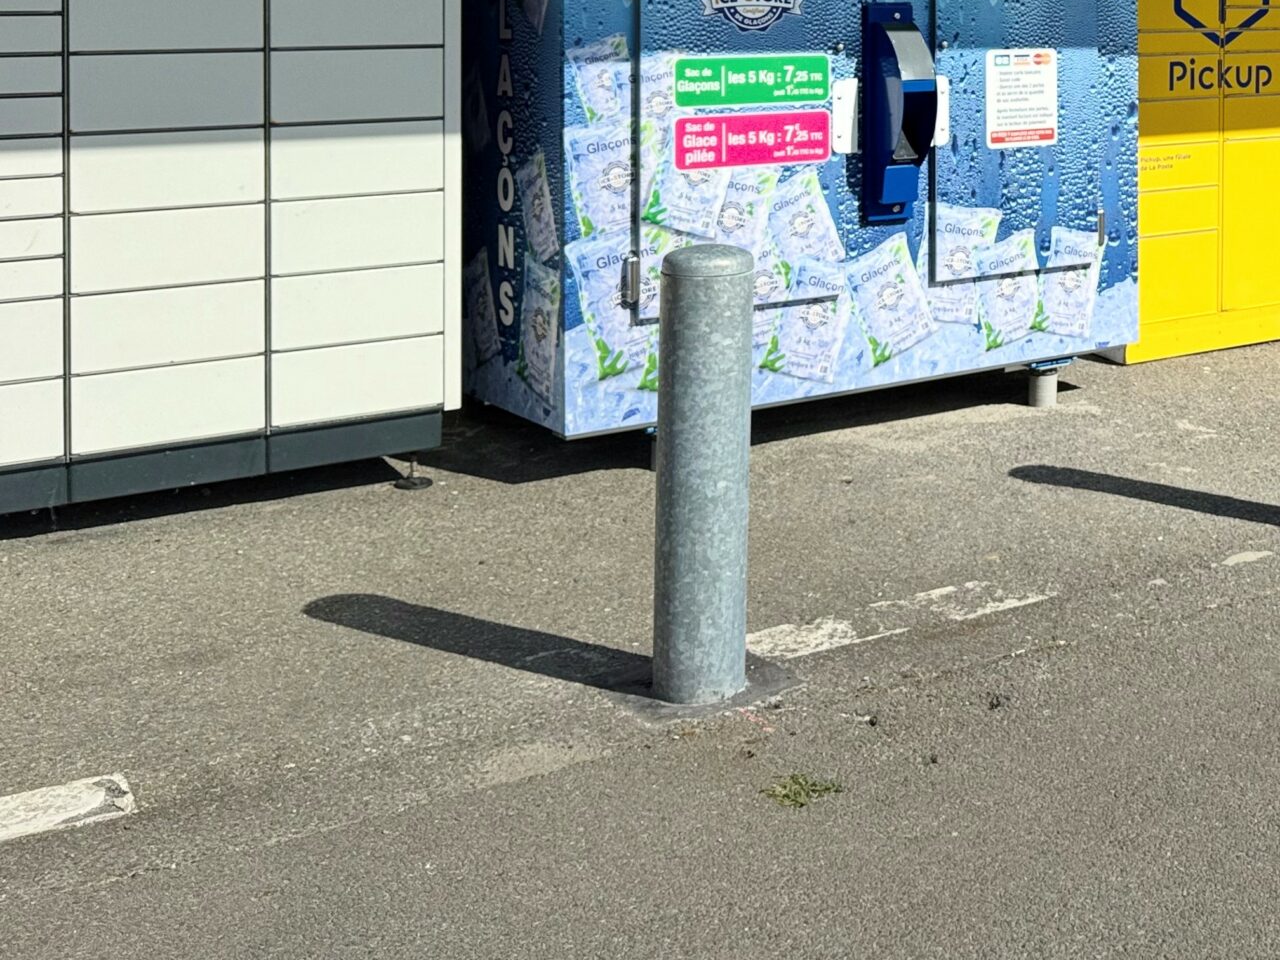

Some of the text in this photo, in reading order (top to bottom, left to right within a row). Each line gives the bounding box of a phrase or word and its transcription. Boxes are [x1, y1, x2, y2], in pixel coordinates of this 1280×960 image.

[684, 68, 713, 77] Sac de
[728, 71, 746, 84] les
[748, 70, 757, 83] 5
[758, 69, 775, 85] Kg
[1168, 57, 1273, 94] Pickup
[677, 80, 720, 94] Glaçons
[684, 121, 715, 133] Sac de
[682, 134, 718, 148] Glace
[728, 132, 746, 145] les
[748, 131, 757, 144] 5
[758, 130, 775, 146] Kg
[684, 150, 716, 166] pilée
[728, 180, 761, 194] açons
[944, 222, 984, 238] Glaçons
[860, 258, 900, 283] Glaçons
[807, 275, 846, 292] Glaçon
